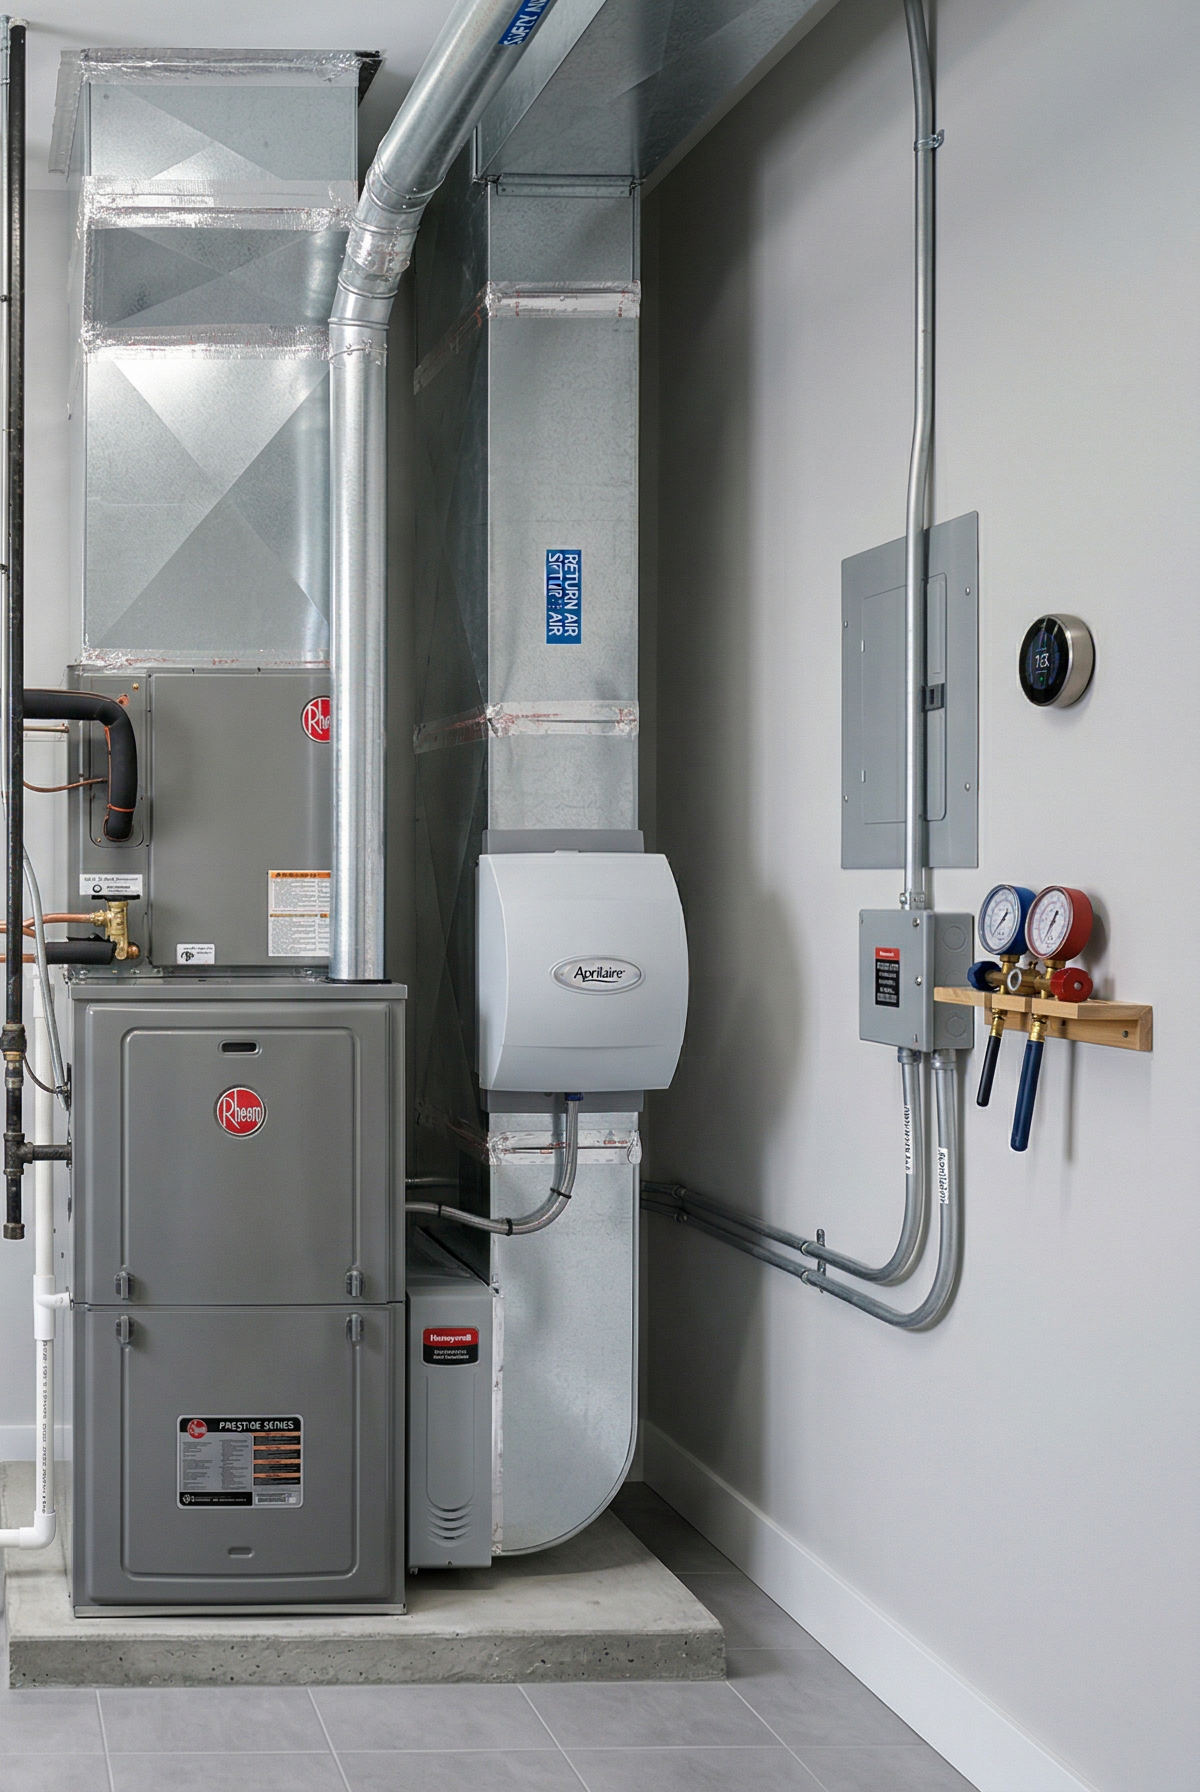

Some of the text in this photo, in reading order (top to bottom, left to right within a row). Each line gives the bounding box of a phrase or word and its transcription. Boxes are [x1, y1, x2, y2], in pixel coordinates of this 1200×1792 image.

[564, 554, 579, 637] RETURN AIR
[548, 611, 563, 636] AIR
[573, 965, 623, 983] Aprilaire
